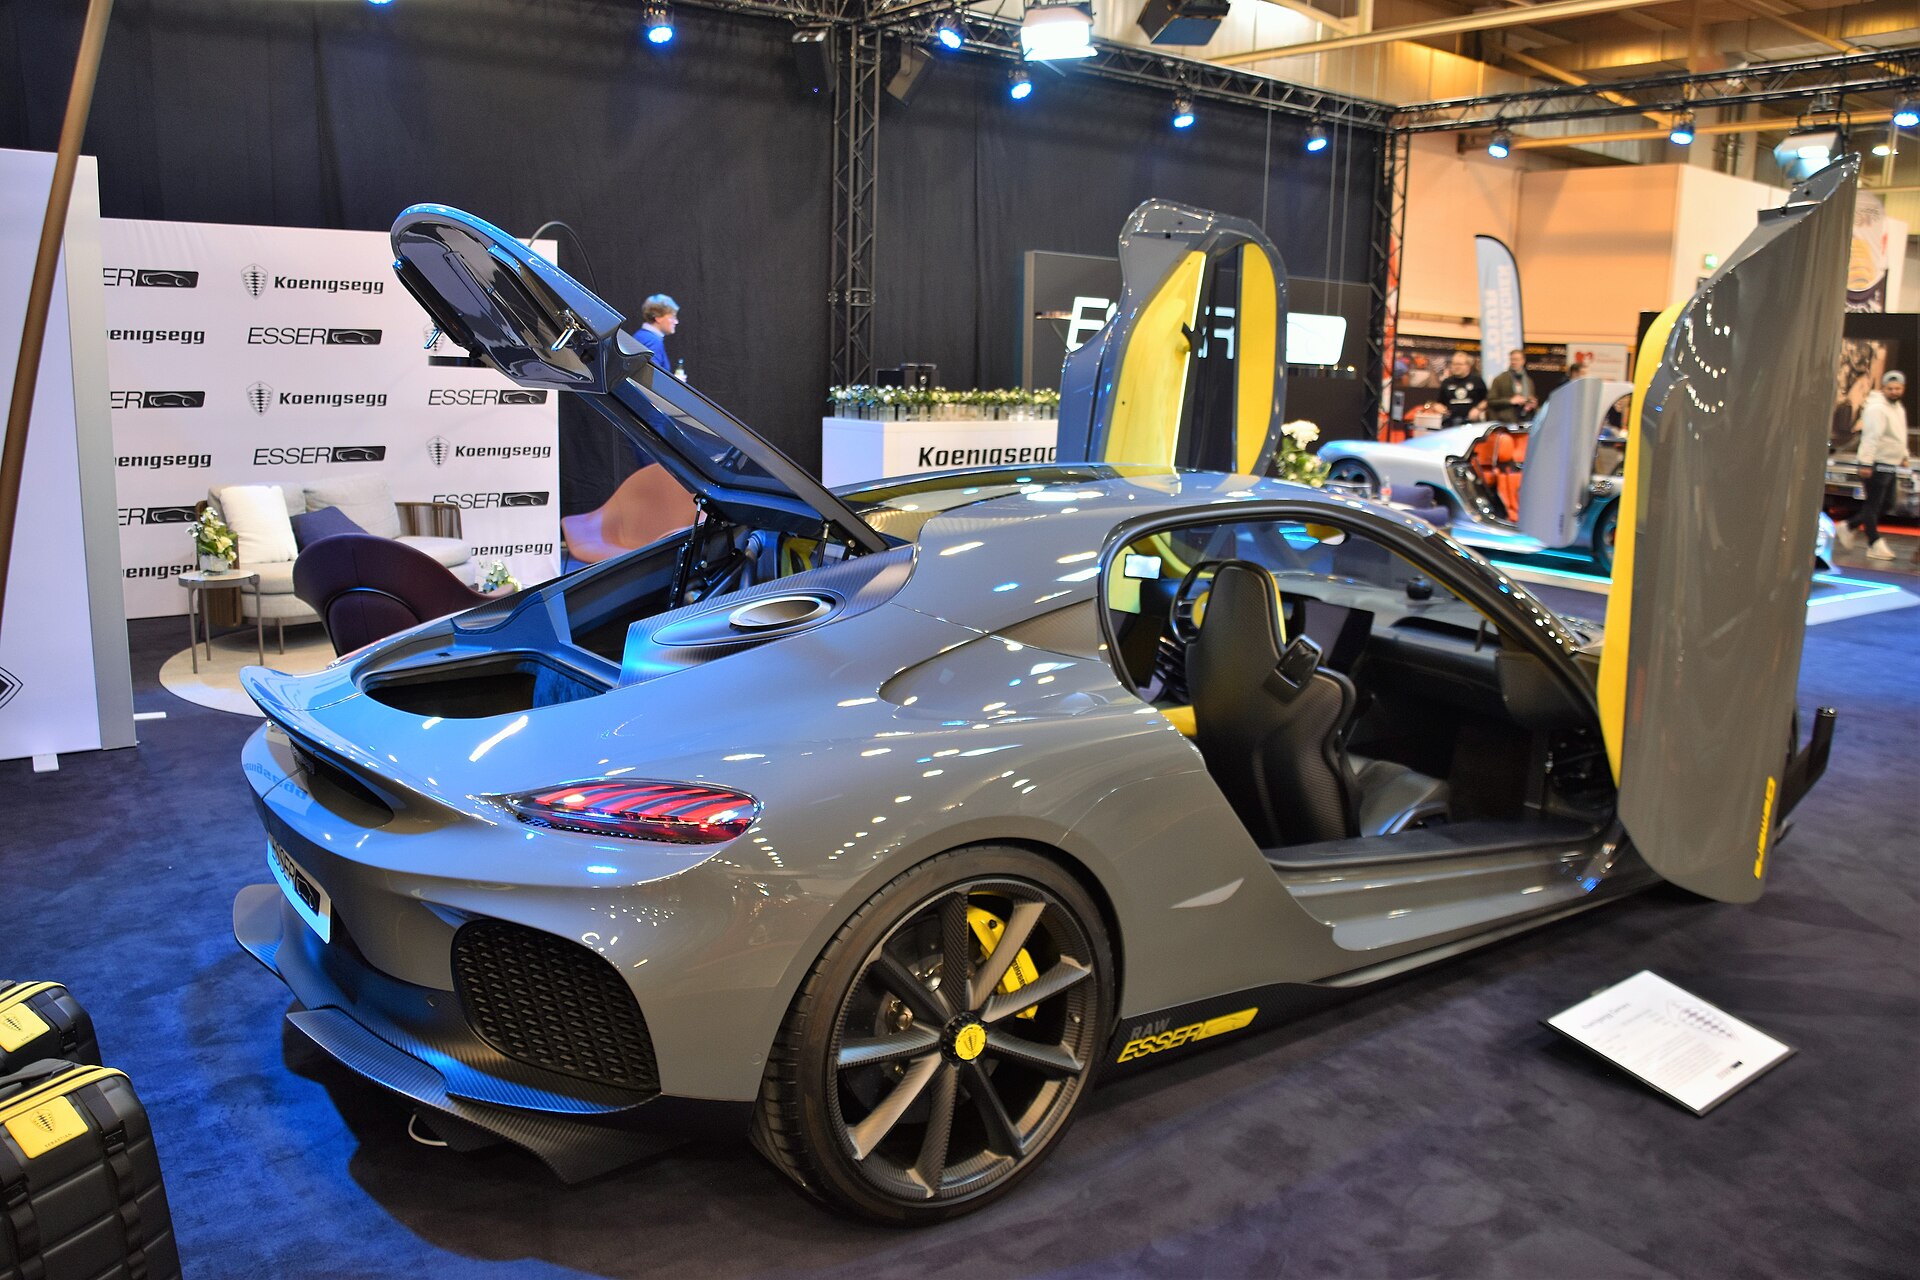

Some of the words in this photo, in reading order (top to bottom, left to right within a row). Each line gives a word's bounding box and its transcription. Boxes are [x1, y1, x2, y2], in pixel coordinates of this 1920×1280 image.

[274, 276, 384, 294] Koenigsegg
[106, 329, 205, 345] enigsegg
[247, 327, 327, 345] ESSER
[279, 392, 388, 408] Koenigsegg
[428, 389, 499, 405] ESSER
[253, 447, 331, 466] ESSER
[455, 445, 552, 459] Koenigsegg
[114, 454, 212, 469] enigsegg
[122, 563, 198, 580] enigse
[1129, 1018, 1171, 1041] RAW
[1116, 1021, 1204, 1064] ESSER
